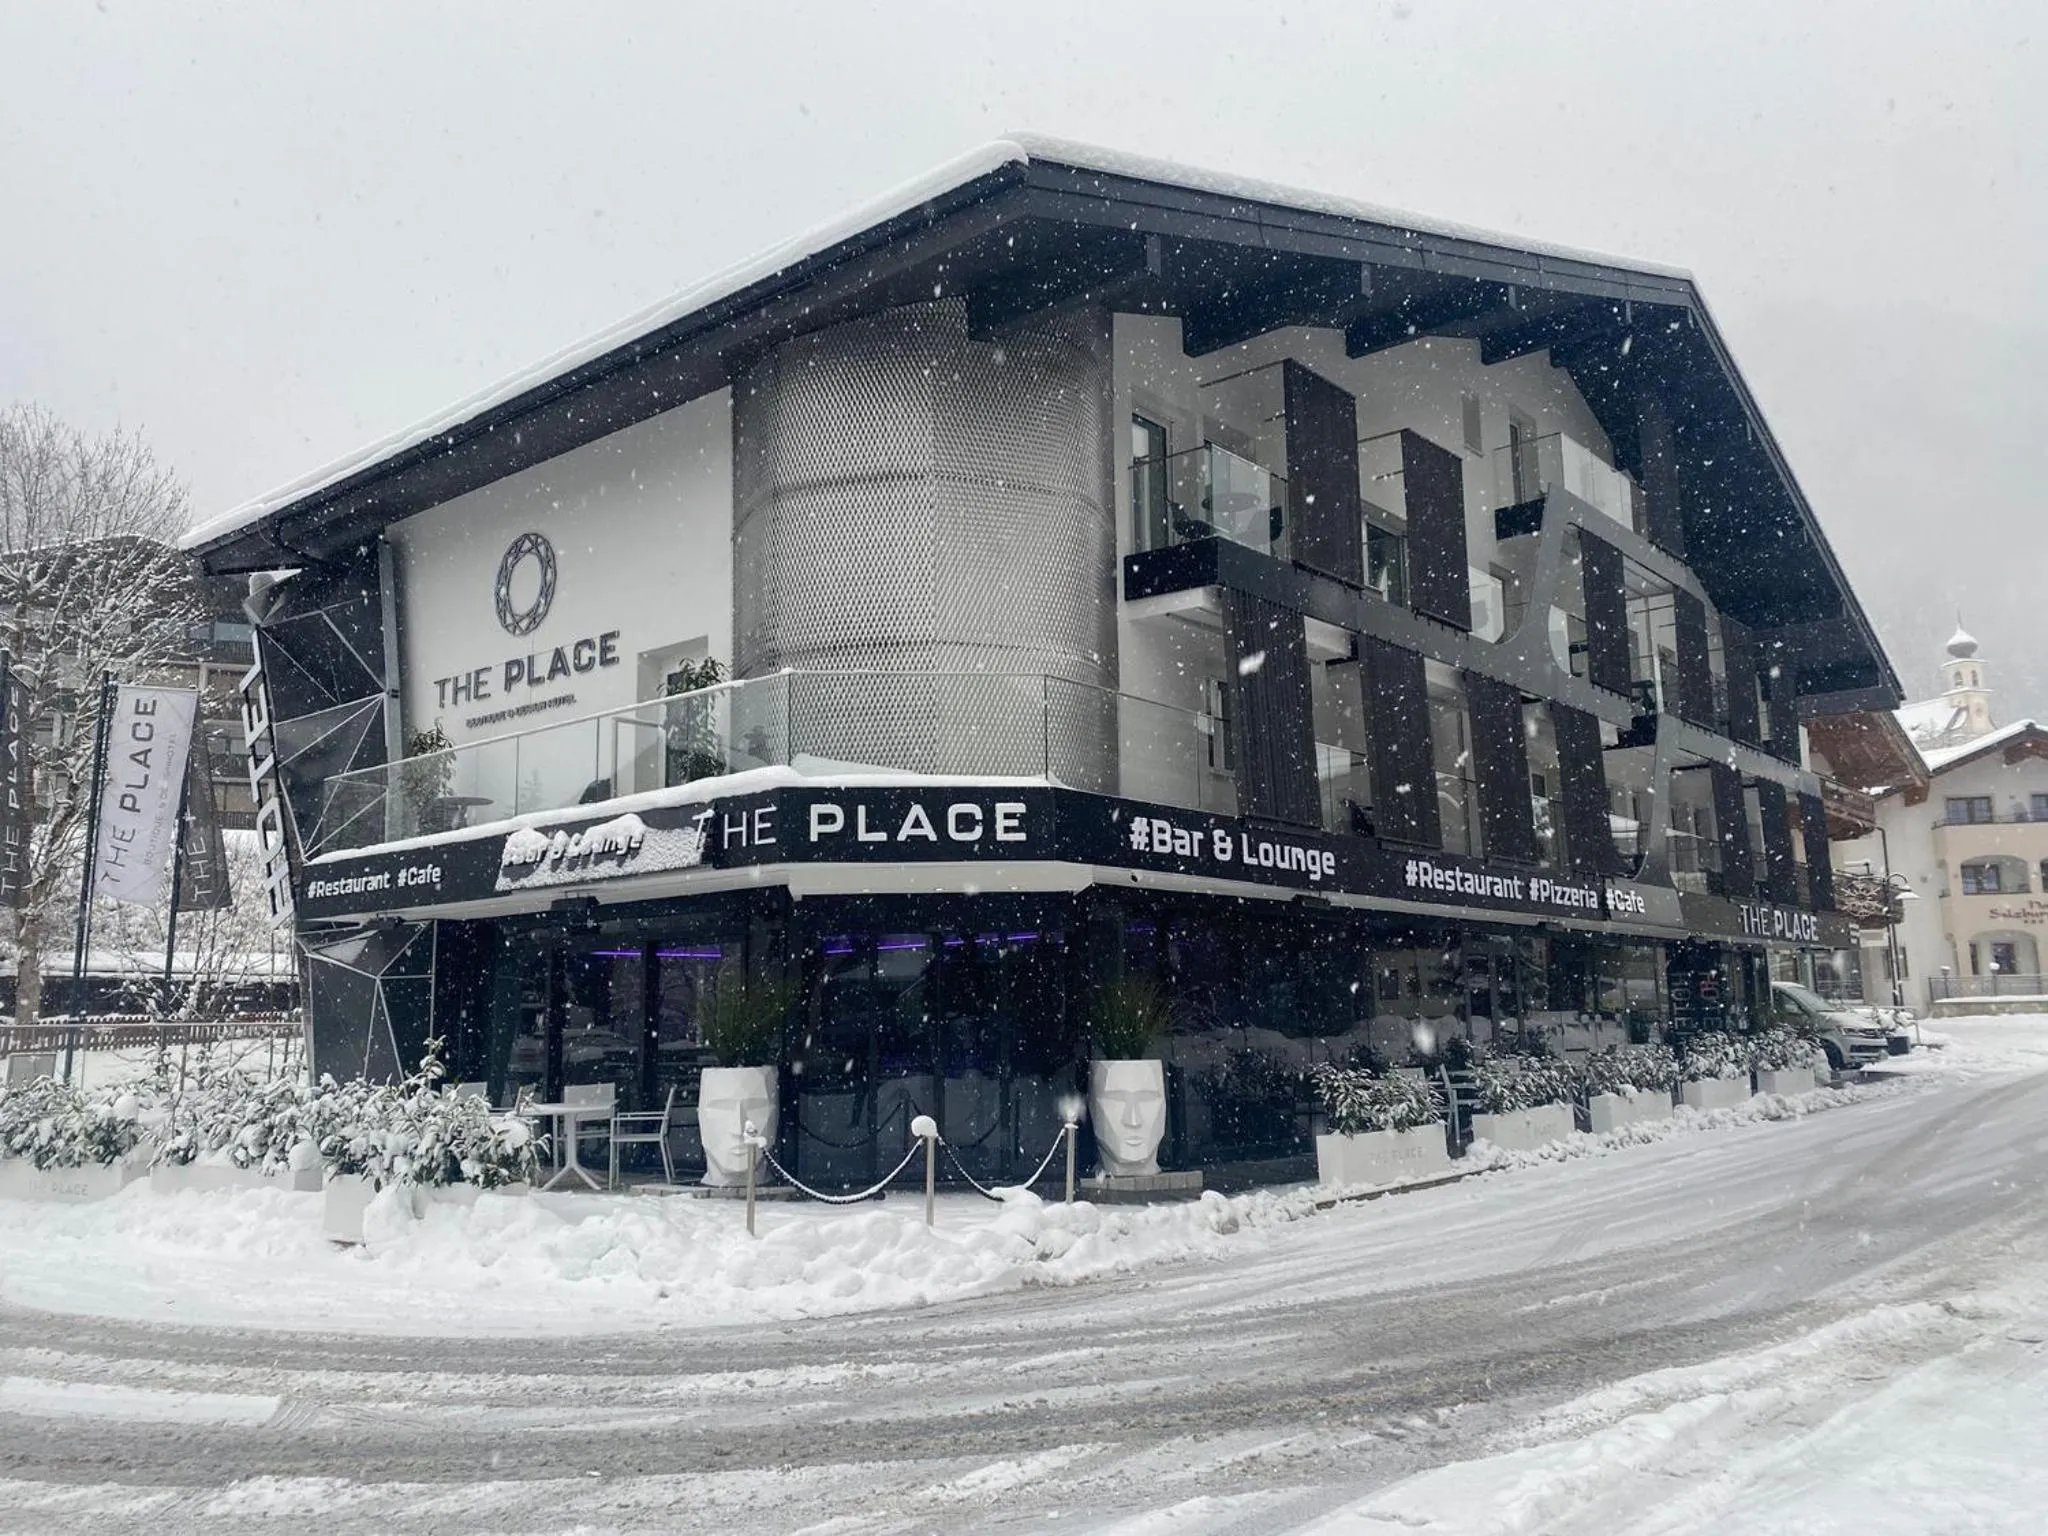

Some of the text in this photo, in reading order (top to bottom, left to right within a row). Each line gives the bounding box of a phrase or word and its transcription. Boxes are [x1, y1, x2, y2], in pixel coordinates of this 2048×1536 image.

[434, 630, 620, 708] THE PLACE
[0, 686, 20, 888] THE PLACE
[100, 698, 157, 883] THE PLACE
[239, 630, 295, 930] HOTEL
[692, 801, 1027, 851] THE PLACE
[1129, 816, 1336, 881] #Bar & Lounge
[187, 836, 213, 902] THE
[307, 863, 442, 899] #Restaurant #Cafe
[1405, 859, 1646, 914] #Restaurant #Pizzeria #Cafe
[1740, 904, 1819, 941] THE PLACE
